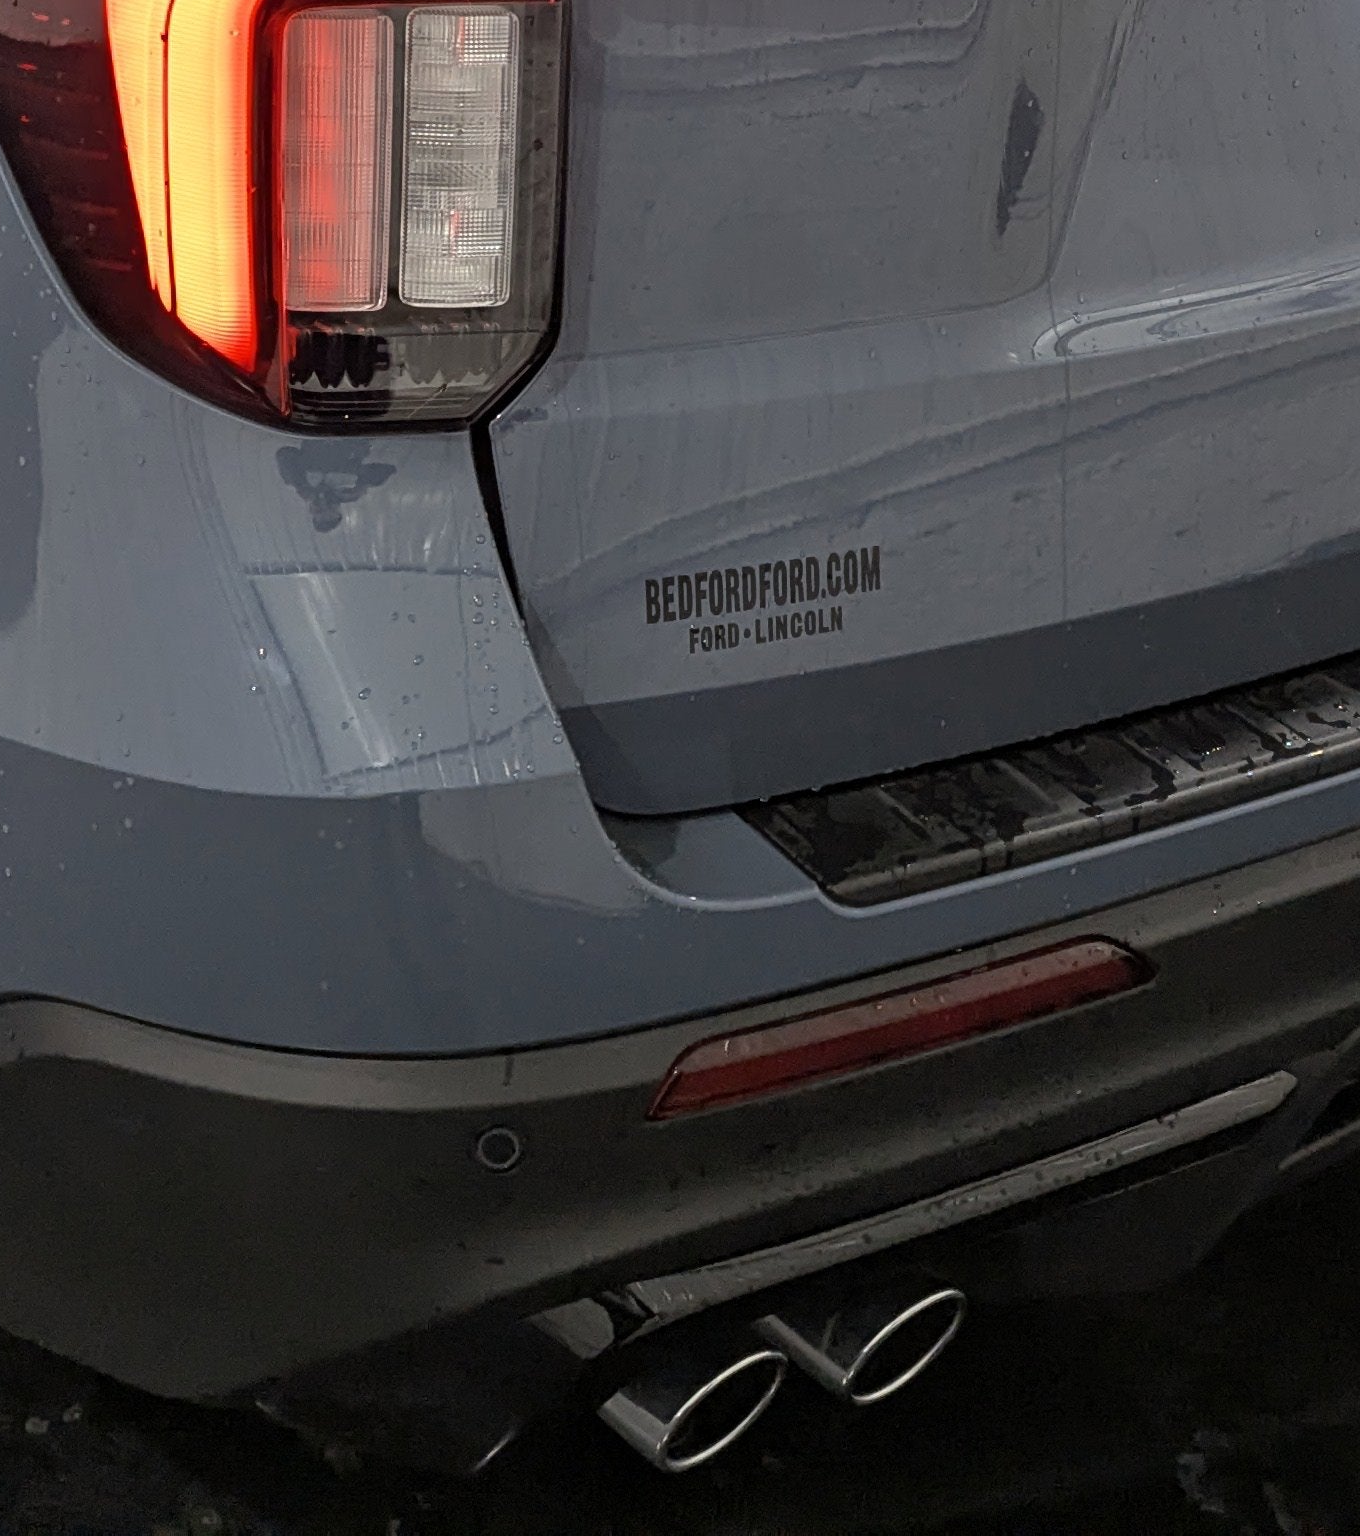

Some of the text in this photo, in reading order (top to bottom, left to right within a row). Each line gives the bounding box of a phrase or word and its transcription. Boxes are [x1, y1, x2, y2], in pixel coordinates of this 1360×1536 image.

[645, 545, 881, 625] BEDFORDFORD.COM
[689, 605, 843, 654] FORD LINCOLN
